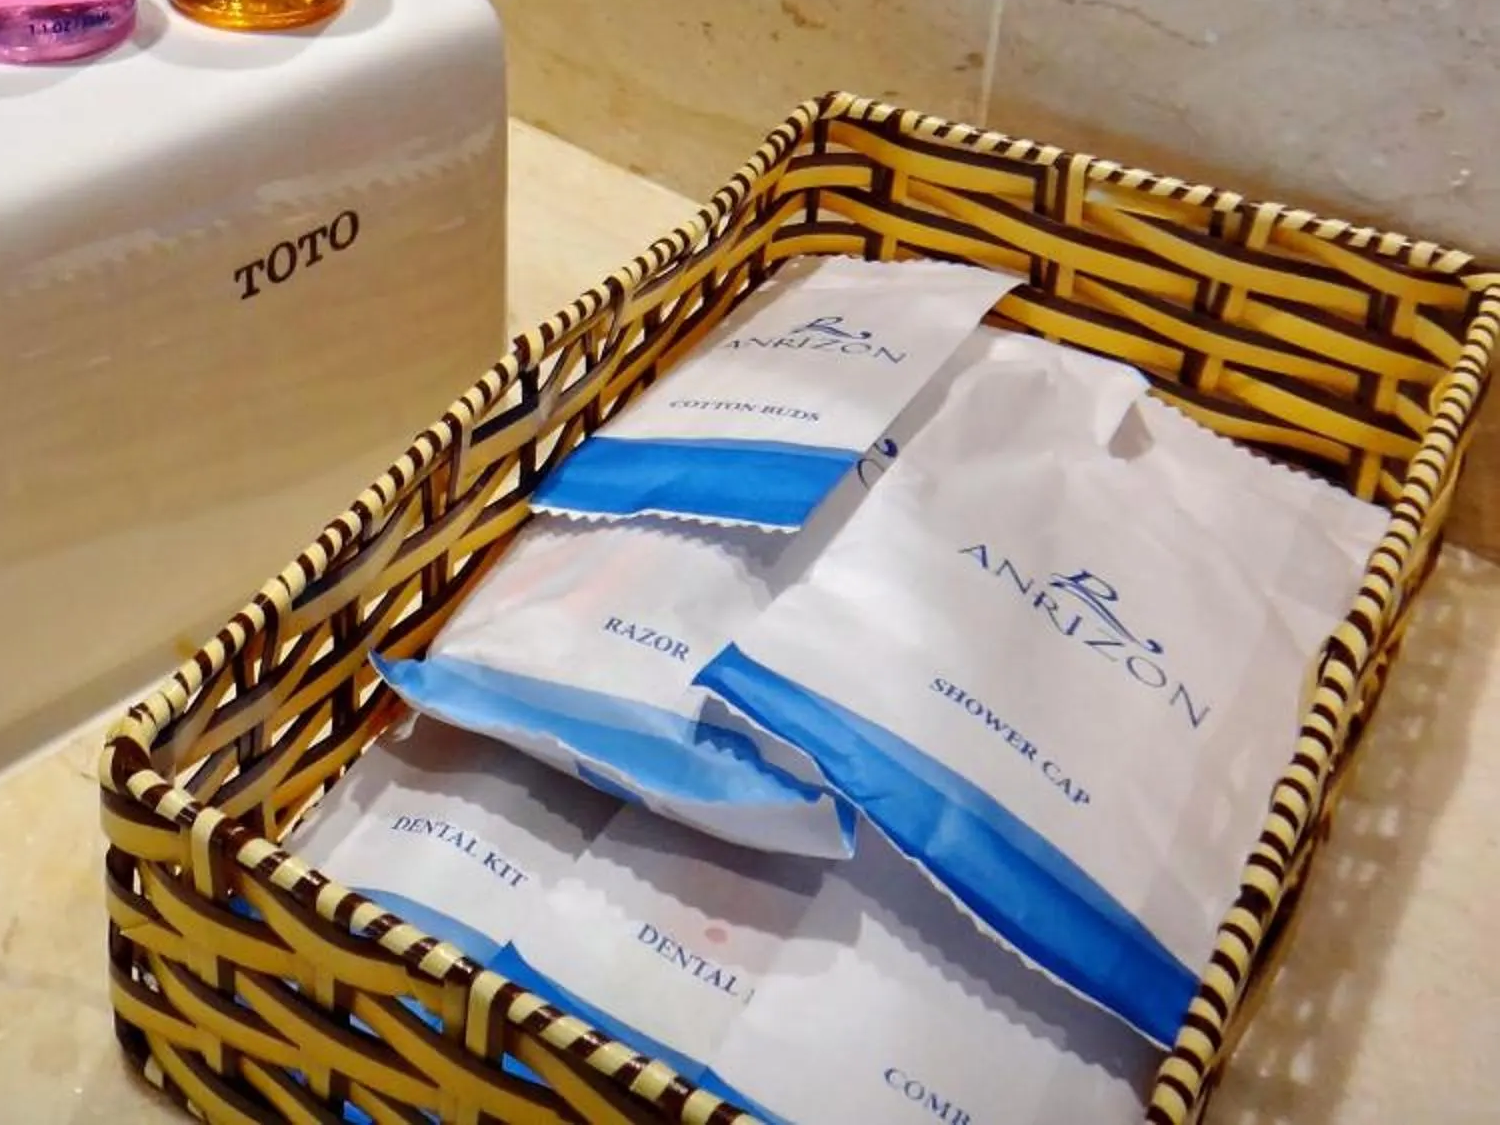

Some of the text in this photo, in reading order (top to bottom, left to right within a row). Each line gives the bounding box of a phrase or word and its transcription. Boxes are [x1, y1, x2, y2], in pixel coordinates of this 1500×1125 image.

[233, 209, 359, 301] TOTO
[724, 336, 907, 364] ANRIZON
[669, 399, 821, 422] COTTON BUDS
[603, 616, 690, 662] RAZOR
[957, 544, 1212, 729] ANRIZON
[928, 677, 1092, 805] SHOWER CAP
[391, 815, 529, 888] DENTAL KIT
[637, 922, 738, 997] DENTAL
